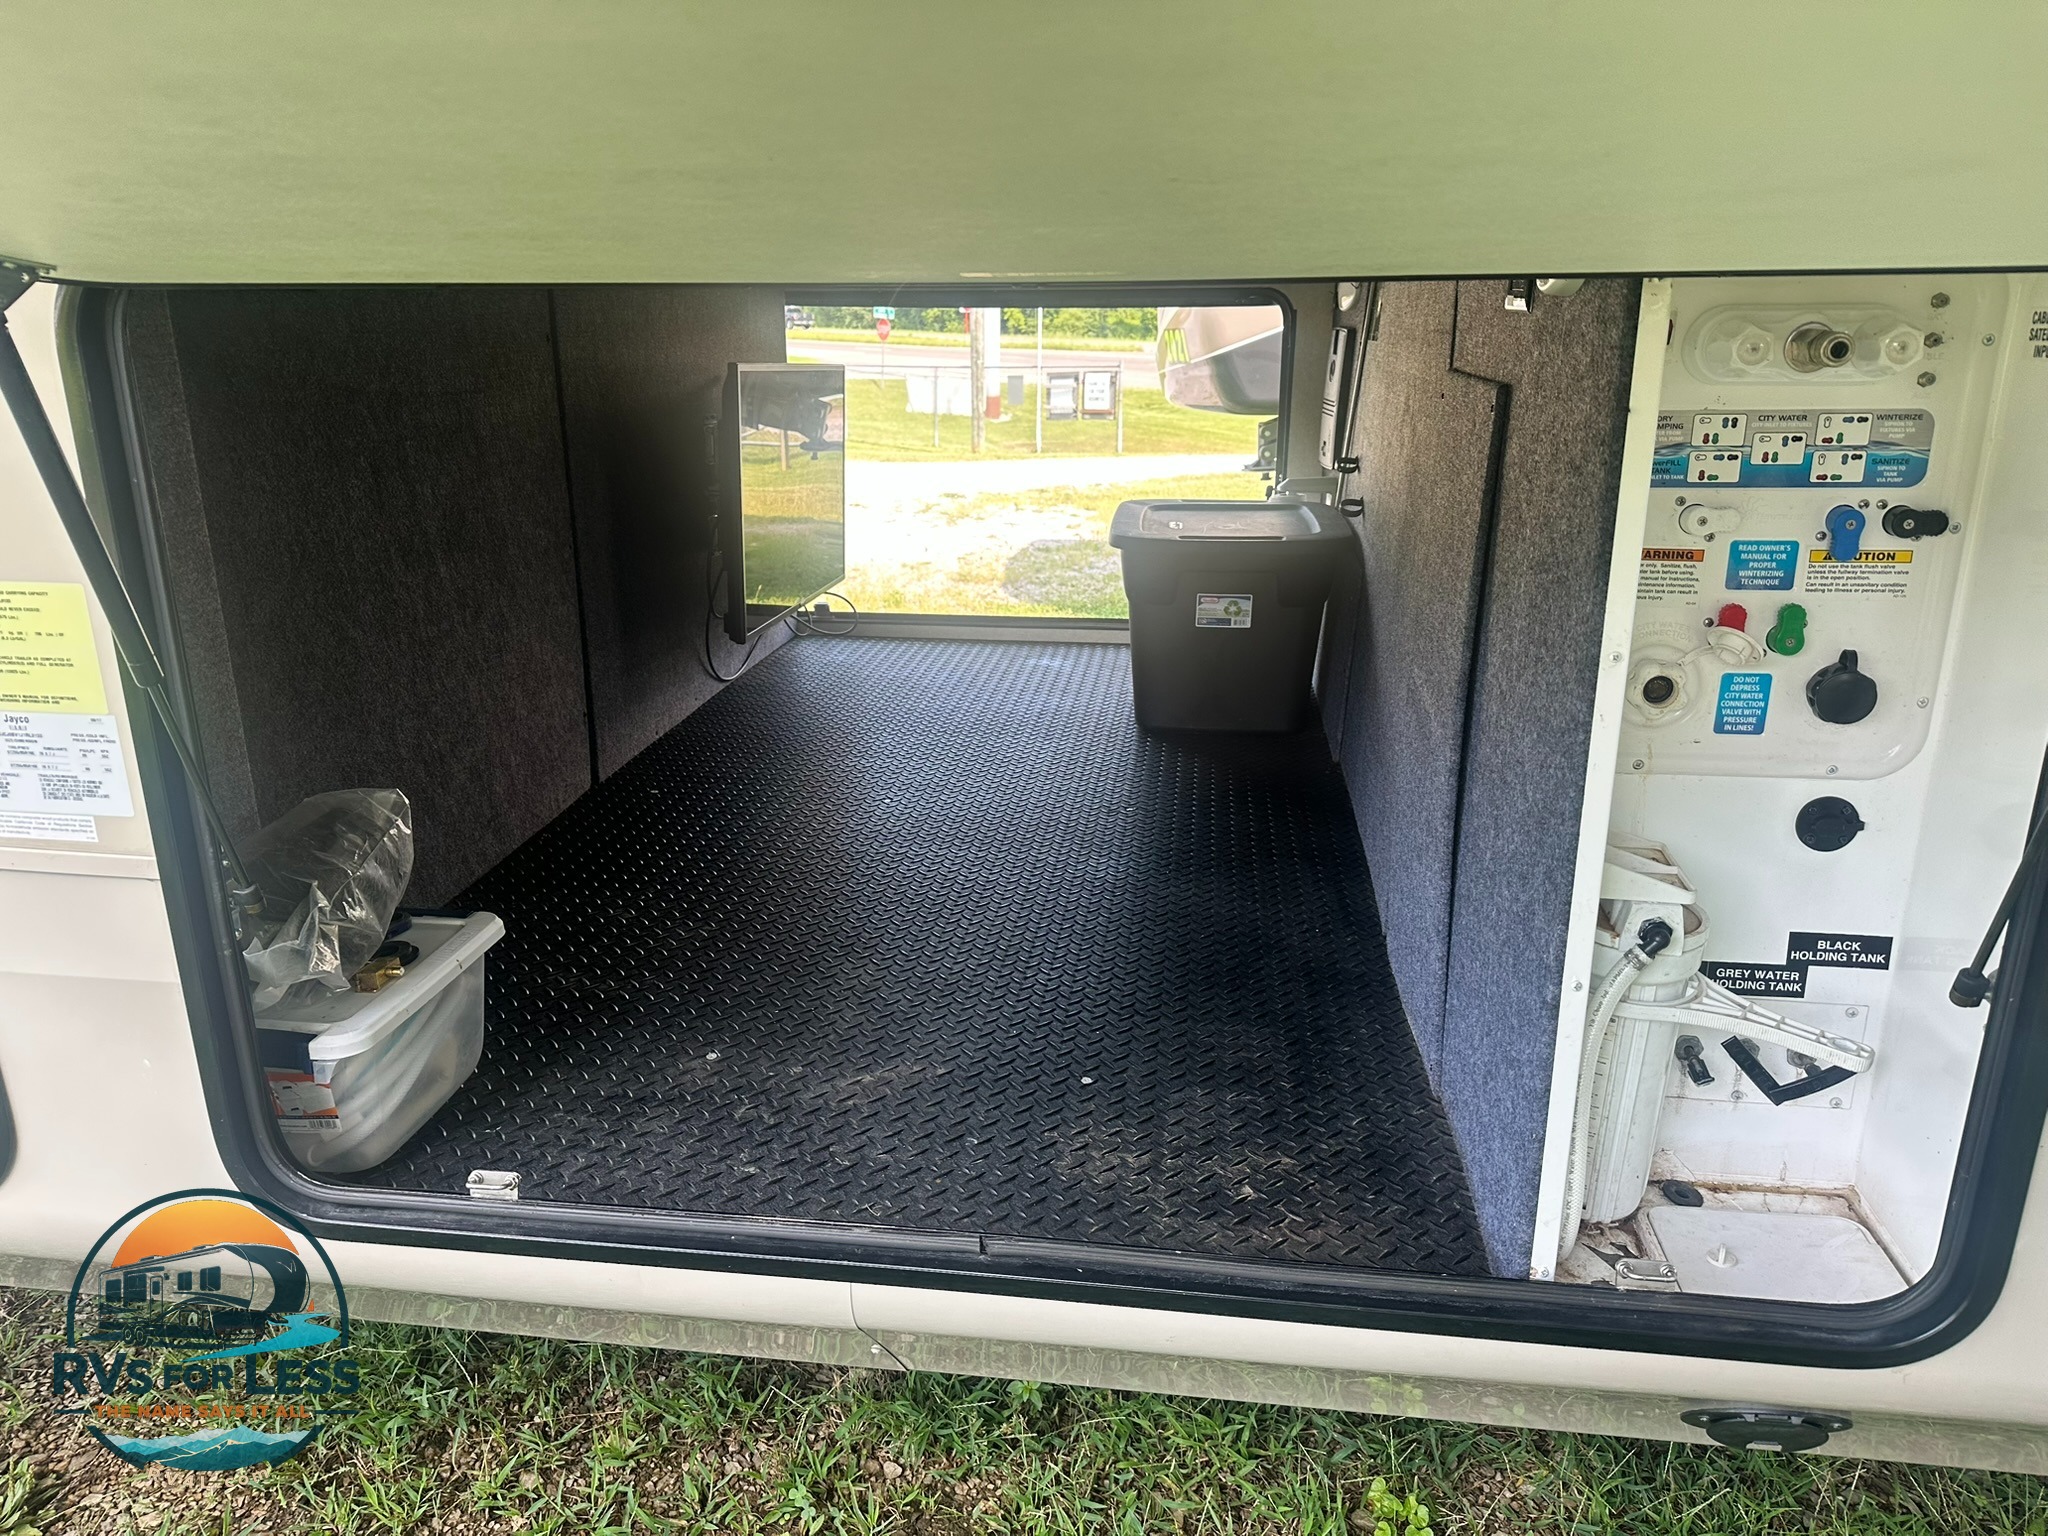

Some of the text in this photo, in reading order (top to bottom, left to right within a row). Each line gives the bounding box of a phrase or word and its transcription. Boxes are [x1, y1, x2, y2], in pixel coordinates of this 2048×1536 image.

[2032, 310, 2048, 324] CAB
[2028, 328, 2048, 341] SATE
[1757, 414, 1808, 422] CITY WATER
[1876, 413, 1924, 421] WINTERIZE
[1871, 457, 1910, 465] SANITIZE
[1758, 544, 1791, 552] OWNER'S
[1642, 550, 1694, 560] ARNING
[1853, 552, 1896, 561] UTION
[1740, 578, 1780, 586] TECHNIQUE
[1720, 700, 1765, 708] CONNECTION
[3, 713, 30, 724] Jayco
[1817, 940, 1861, 951] BLACK
[1790, 951, 1886, 963] HOLDING TANK
[1716, 968, 1800, 981] GREY WATER
[1769, 981, 1803, 992] TANK
